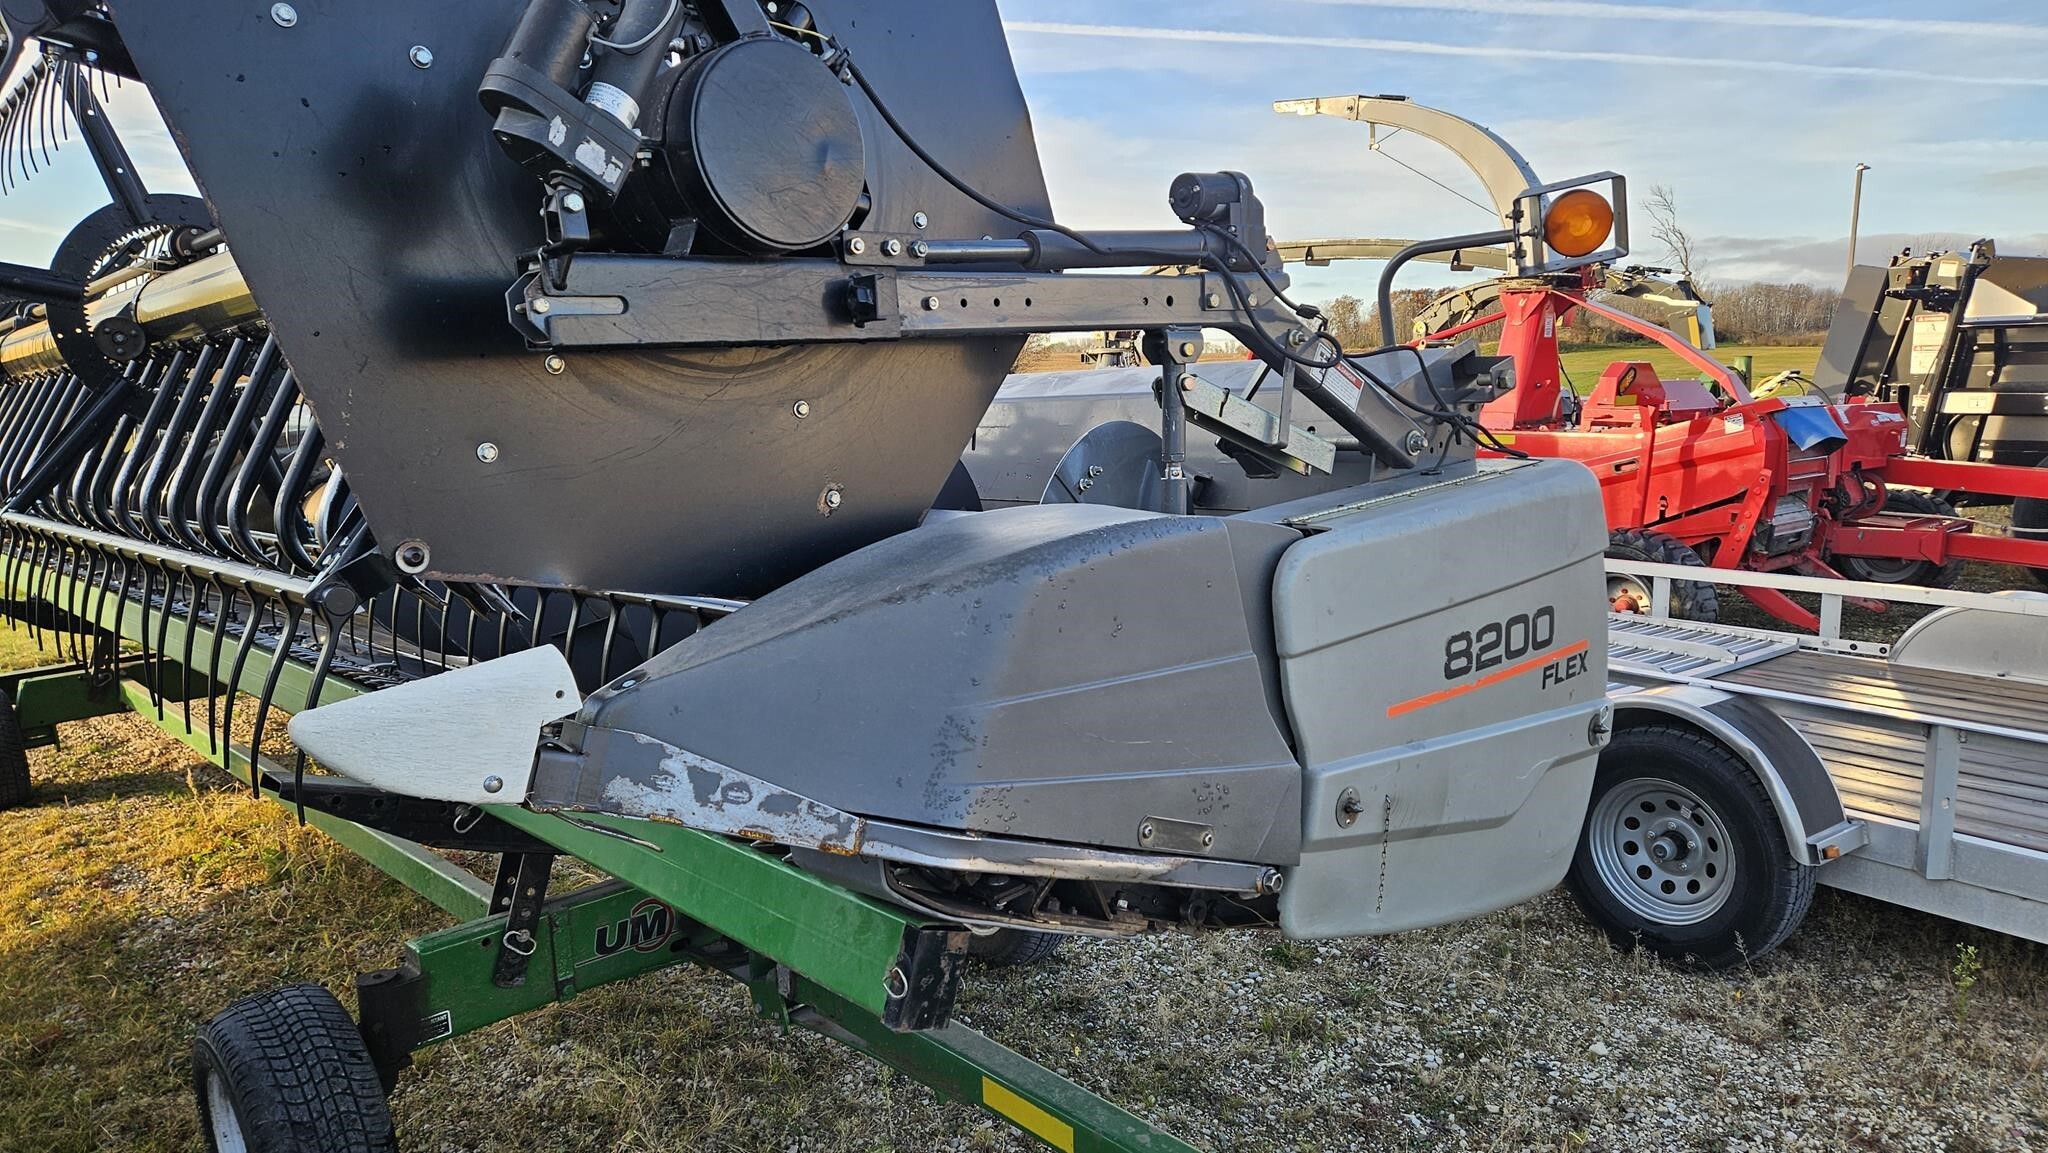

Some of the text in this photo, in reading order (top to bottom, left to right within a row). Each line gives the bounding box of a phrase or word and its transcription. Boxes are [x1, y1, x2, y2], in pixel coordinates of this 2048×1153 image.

[1444, 605, 1554, 680] 8200
[1541, 650, 1589, 690] FLEX
[595, 906, 669, 957] UM
